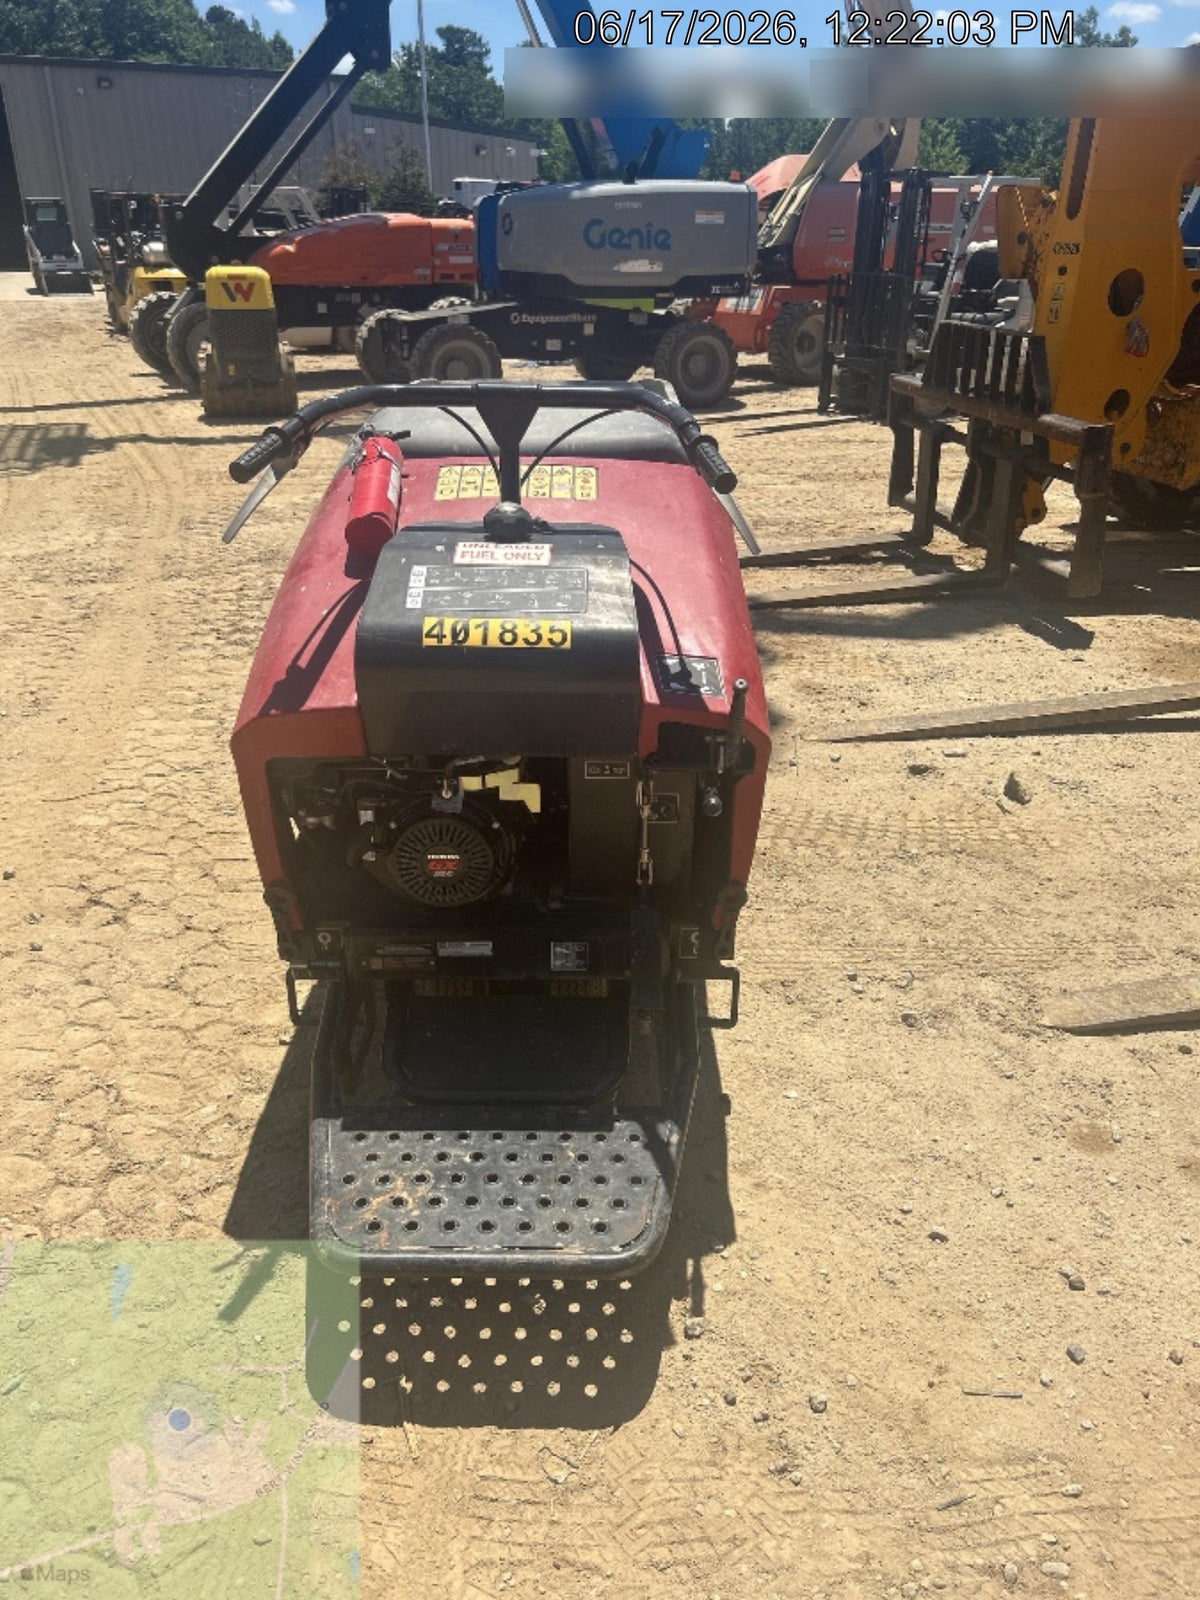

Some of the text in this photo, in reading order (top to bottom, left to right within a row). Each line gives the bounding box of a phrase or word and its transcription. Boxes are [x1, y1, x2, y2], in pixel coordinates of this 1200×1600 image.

[583, 218, 672, 251] Genie
[460, 550, 545, 561] FUEL ONLY
[424, 618, 569, 647] 401835
